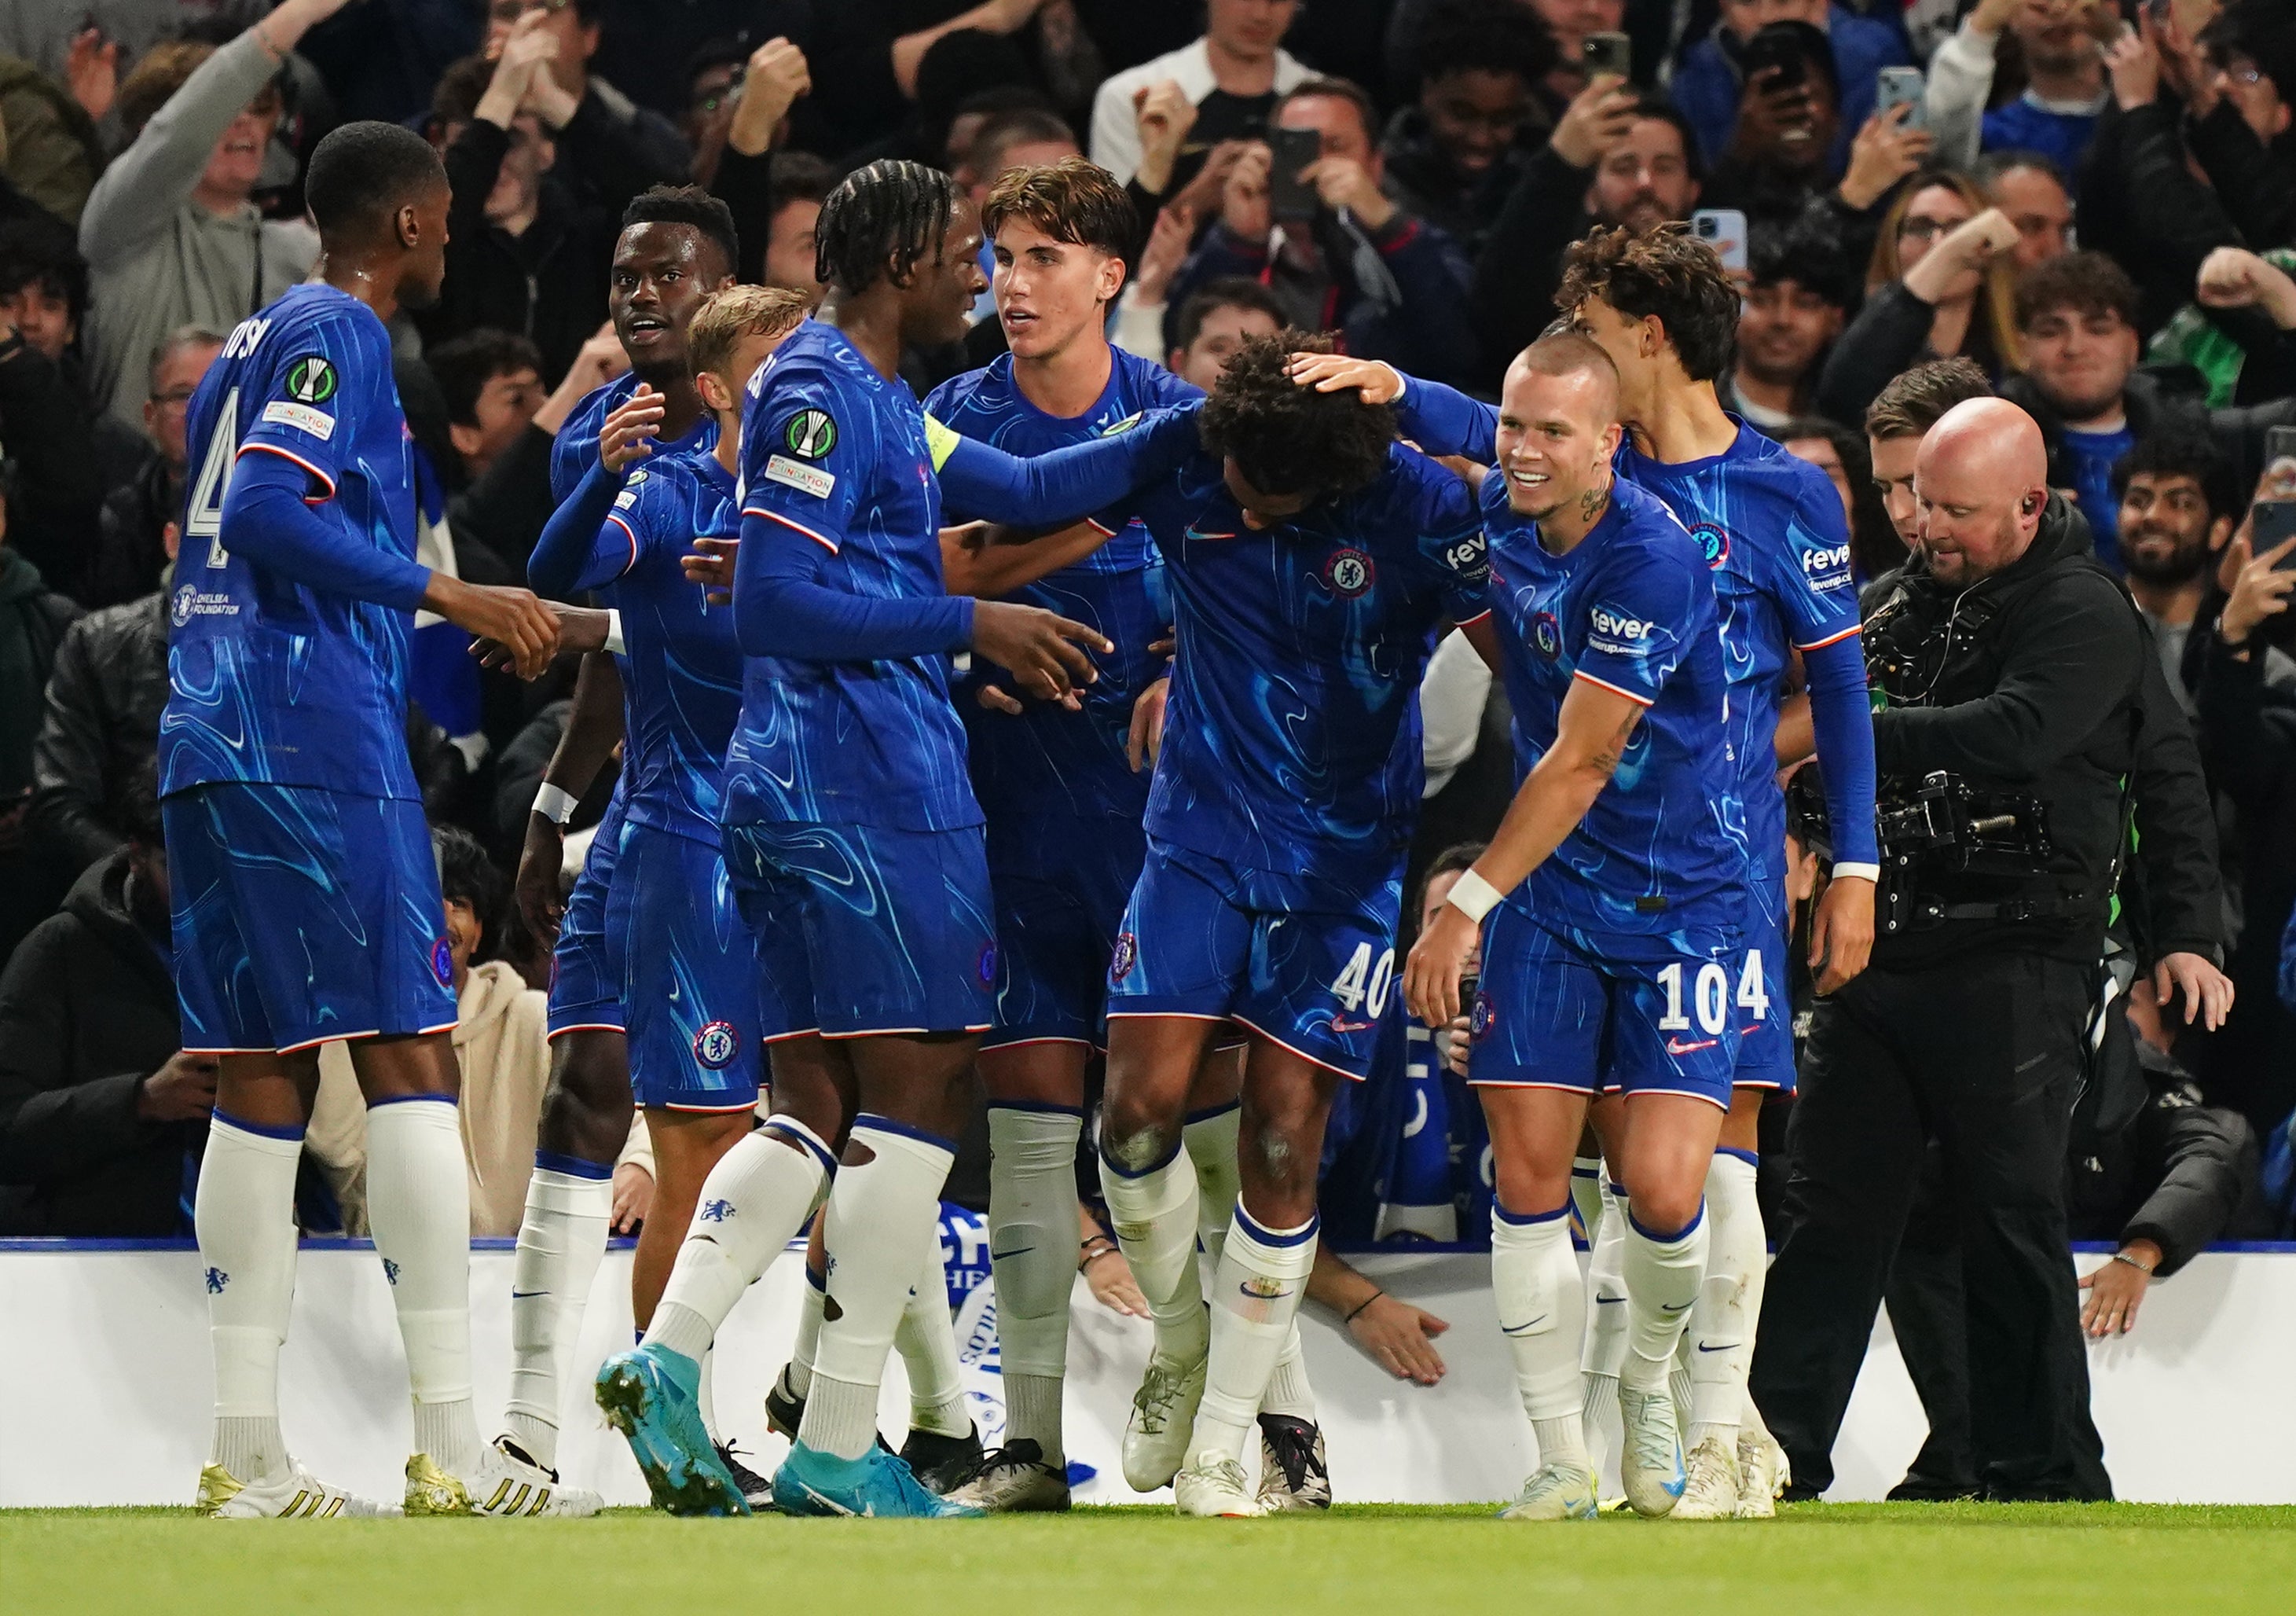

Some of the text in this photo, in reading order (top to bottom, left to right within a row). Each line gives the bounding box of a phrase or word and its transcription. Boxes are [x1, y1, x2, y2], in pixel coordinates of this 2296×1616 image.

[186, 385, 240, 569] 4
[768, 461, 830, 490] FOUNDATION
[193, 604, 240, 615] FOUNDATION
[196, 593, 229, 604] CHELSEA
[1591, 608, 1654, 641] fever
[1330, 941, 1395, 1019] 40
[1656, 962, 1728, 1036] 10
[1737, 948, 1770, 1020] 4
